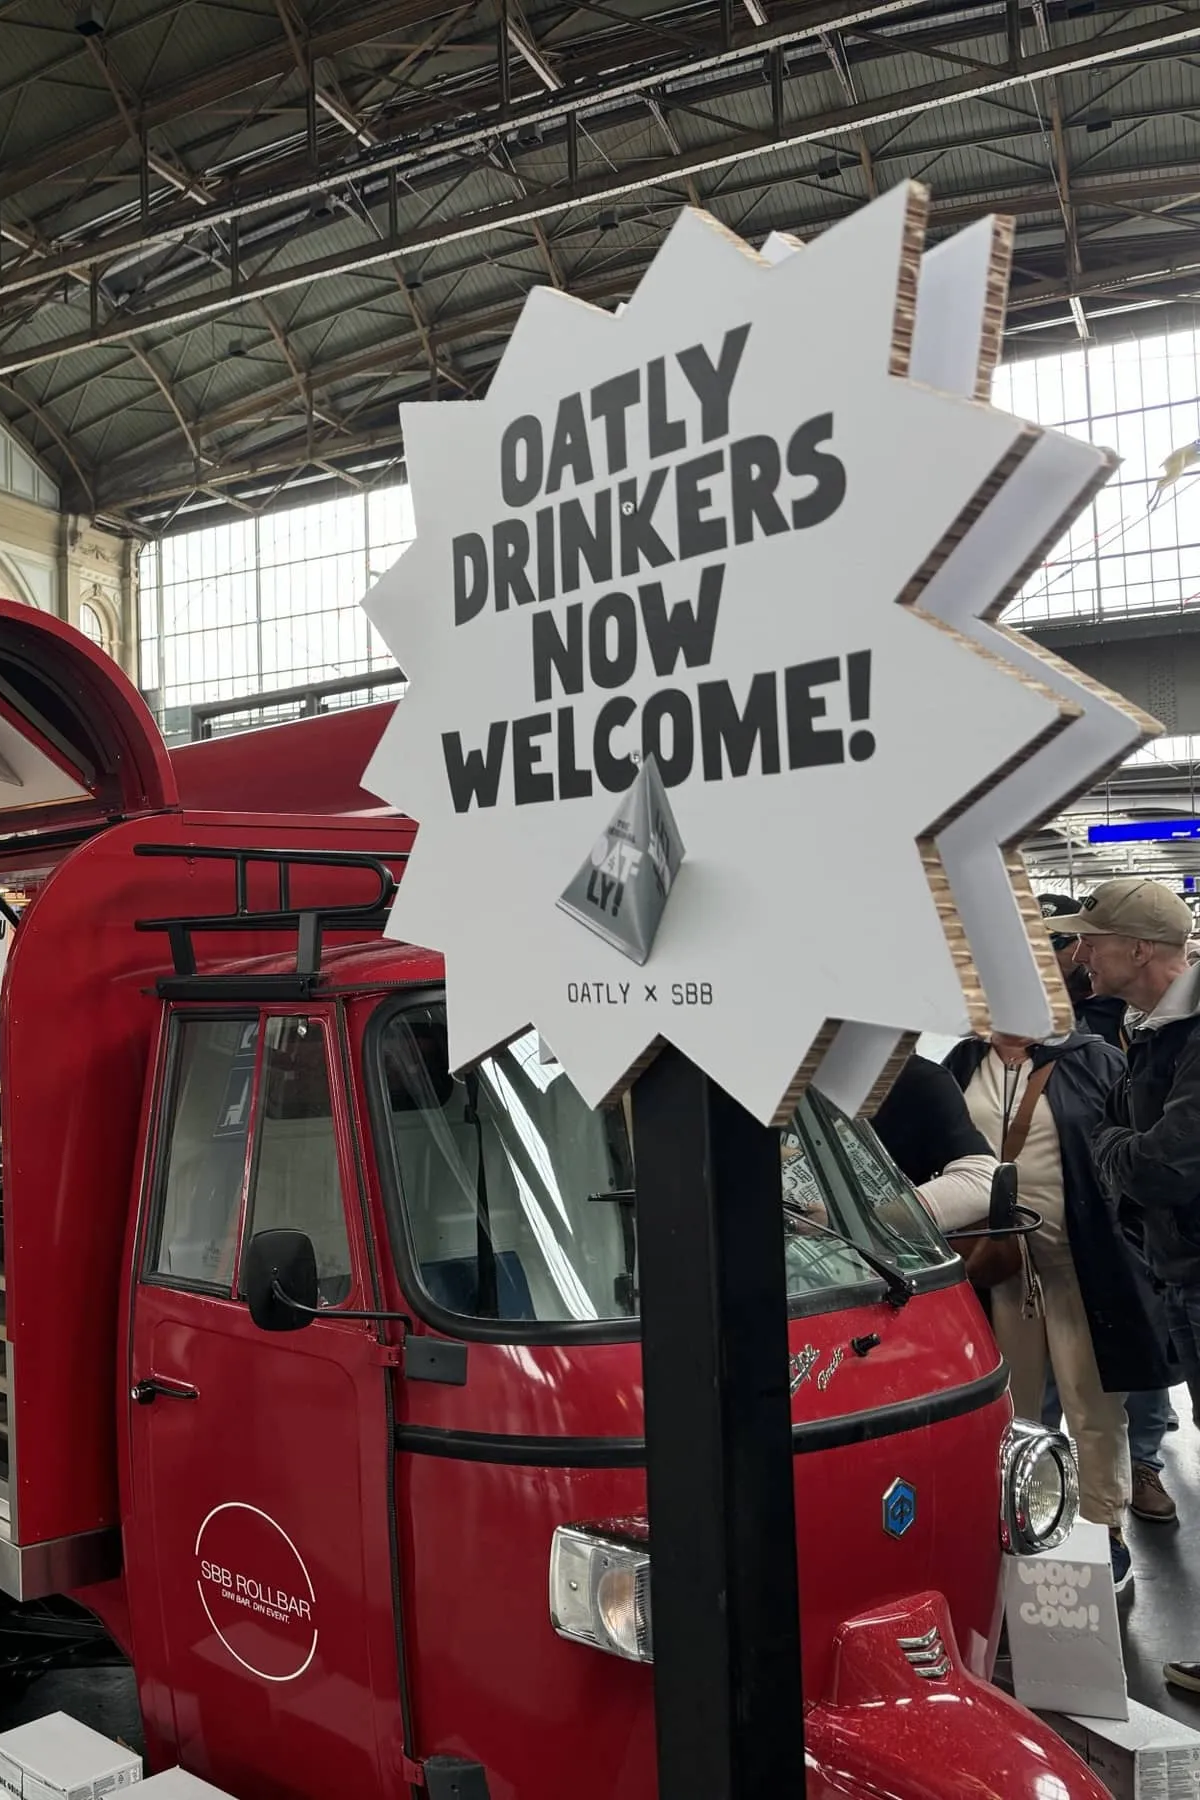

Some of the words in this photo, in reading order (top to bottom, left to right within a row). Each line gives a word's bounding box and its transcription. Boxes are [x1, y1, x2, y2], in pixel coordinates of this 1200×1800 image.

[501, 322, 752, 507] OATLY
[452, 411, 847, 627] DRINKERS
[532, 563, 726, 702] NOW
[441, 649, 876, 814] WELCOME!
[586, 869, 625, 918] LY!
[567, 982, 631, 1004] OATLY
[671, 983, 713, 1006] SBB
[201, 1560, 233, 1588] SBB
[235, 1573, 312, 1622] ROLLBAR
[1017, 1561, 1092, 1589] WOW
[1036, 1583, 1079, 1607] NO
[221, 1588, 236, 1601] DINI
[252, 1601, 266, 1615] DIN
[266, 1606, 291, 1625] EVENT.
[1020, 1602, 1100, 1632] COW!
